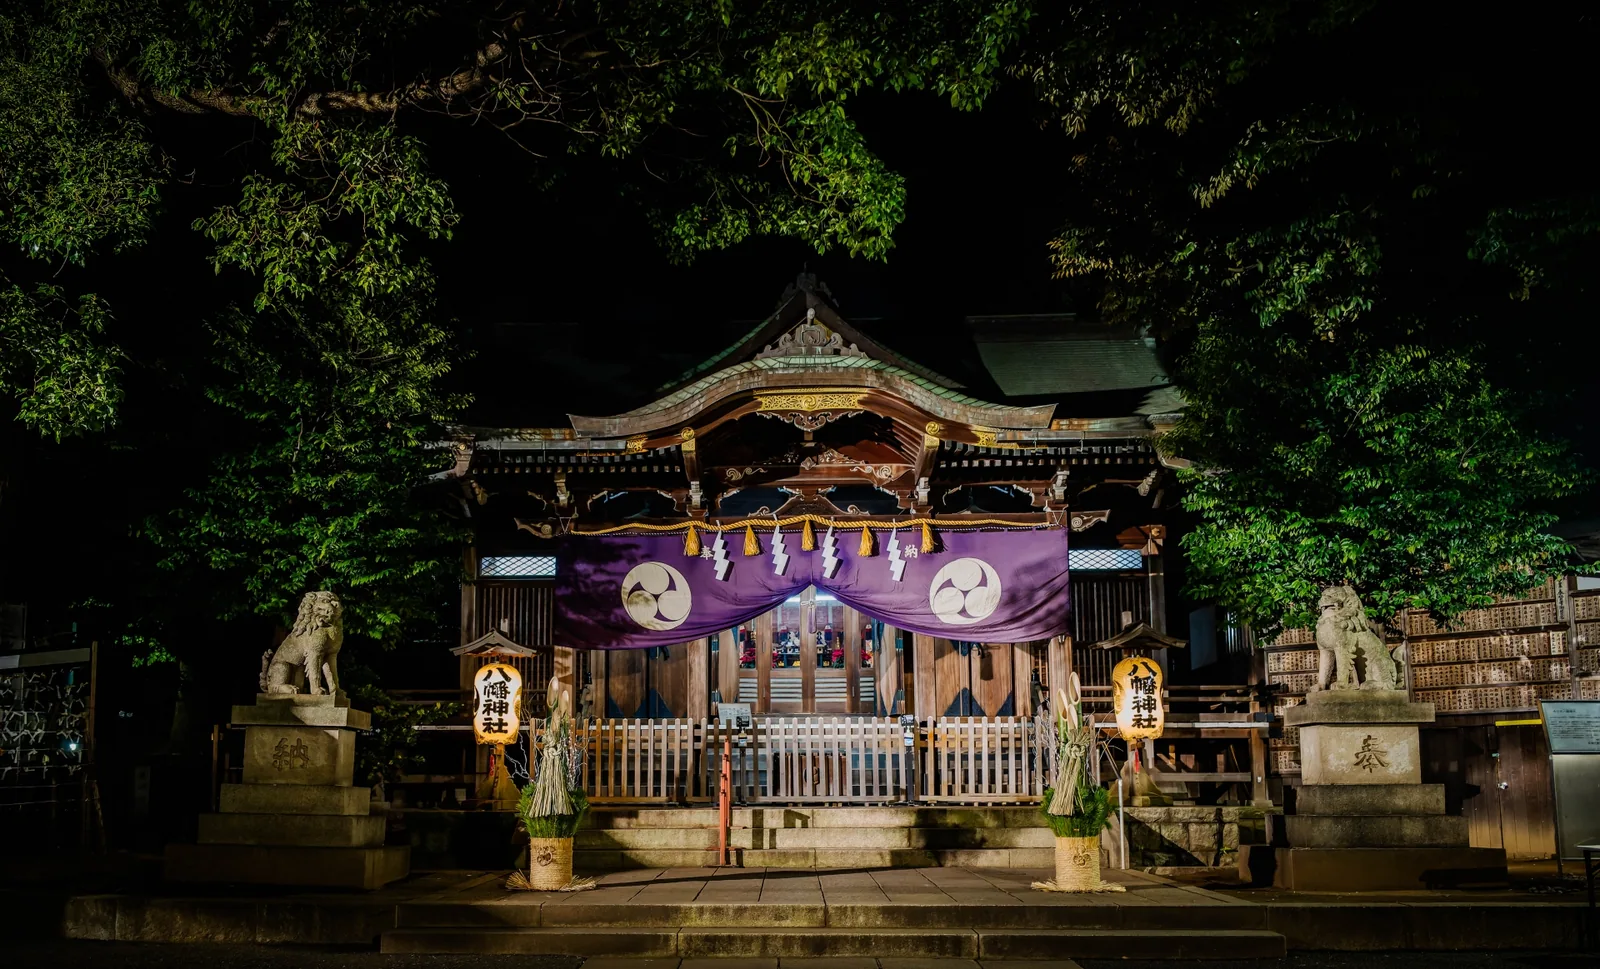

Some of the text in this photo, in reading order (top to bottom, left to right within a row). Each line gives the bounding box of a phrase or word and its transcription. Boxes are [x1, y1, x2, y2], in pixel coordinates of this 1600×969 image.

[700, 544, 918, 560] 奉 納
[482, 667, 512, 734] 八幡神社
[1128, 661, 1157, 729] 八幡神社
[272, 737, 309, 772] 納
[1354, 734, 1389, 773] 奉
